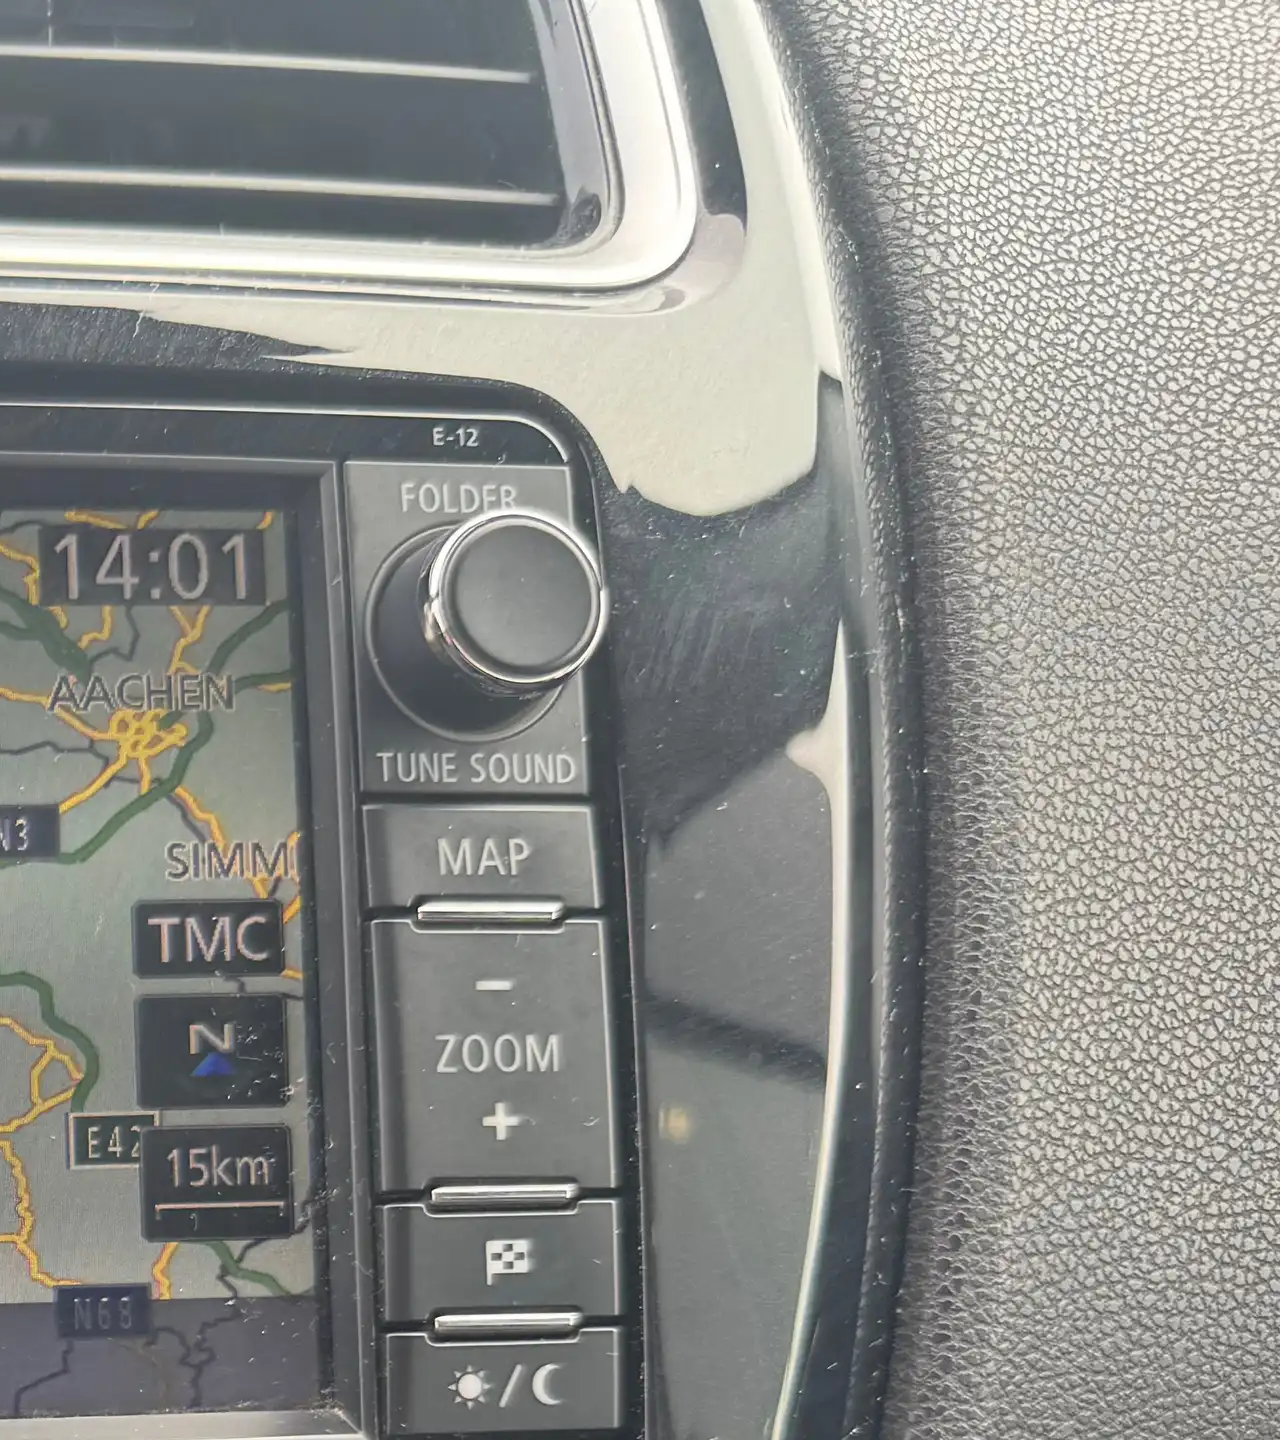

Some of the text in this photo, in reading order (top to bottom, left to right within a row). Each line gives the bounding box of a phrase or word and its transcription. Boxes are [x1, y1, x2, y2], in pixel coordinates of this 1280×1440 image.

[432, 427, 479, 448] E-12
[400, 483, 517, 514] FOLDER
[54, 533, 249, 602] 14:01
[46, 673, 236, 713] AACHEN
[376, 752, 577, 784] TUNE SOUND
[165, 840, 297, 882] SIMM
[437, 838, 531, 877] MAP
[147, 915, 269, 962] TMC
[189, 1023, 234, 1055] N
[434, 1035, 562, 1074] ZOOM
[168, 1148, 271, 1189] 15km
